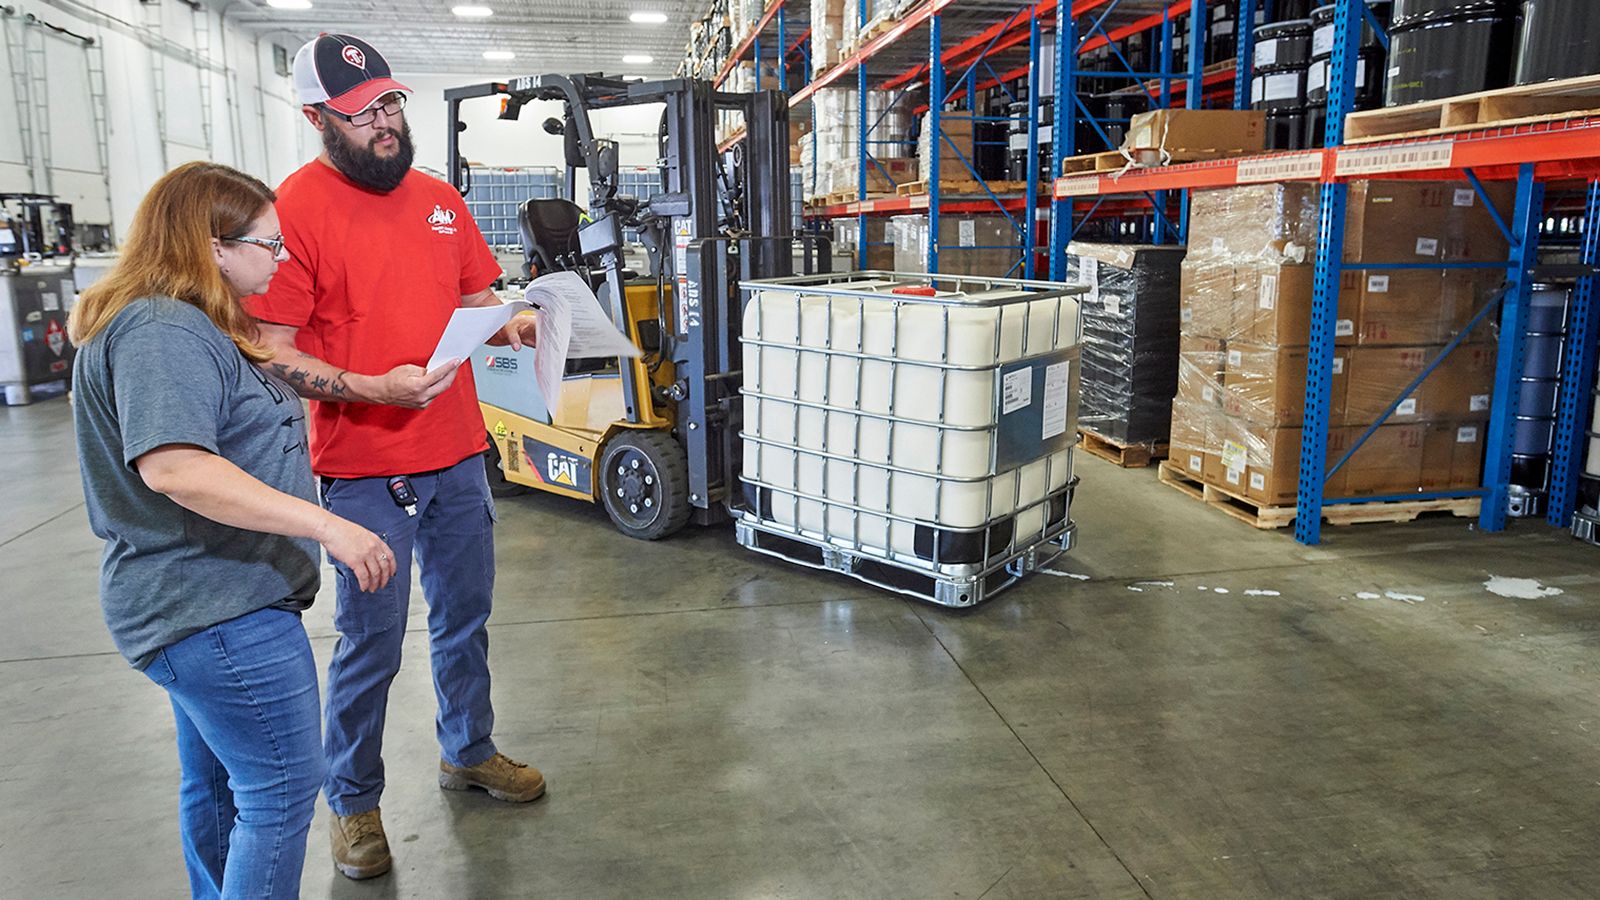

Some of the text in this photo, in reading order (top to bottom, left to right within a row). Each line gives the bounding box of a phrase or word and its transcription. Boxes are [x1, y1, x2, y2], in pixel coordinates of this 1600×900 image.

[674, 219, 692, 236] CAT
[495, 356, 518, 370] SBS
[547, 452, 578, 486] CAT
